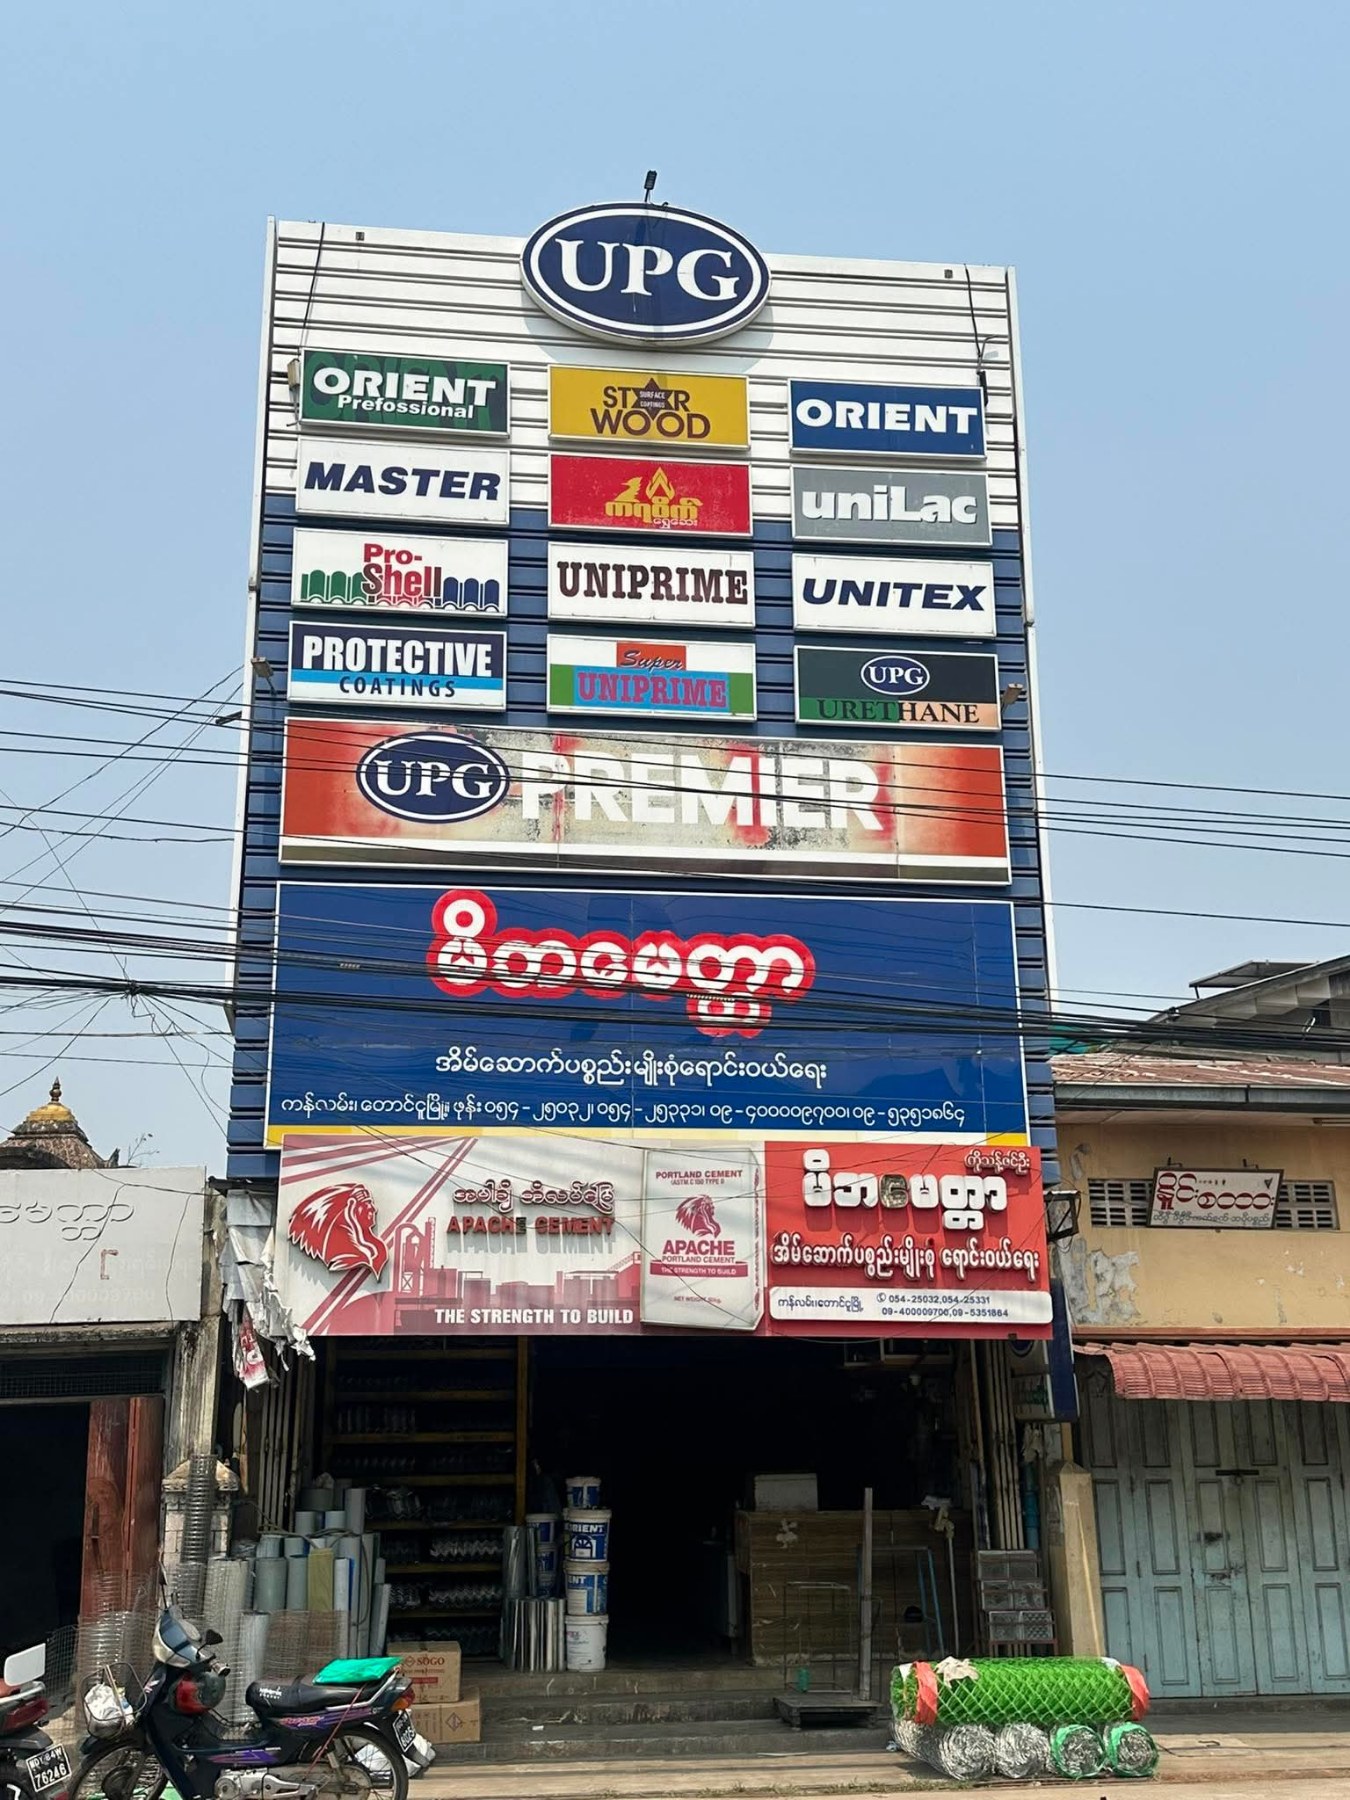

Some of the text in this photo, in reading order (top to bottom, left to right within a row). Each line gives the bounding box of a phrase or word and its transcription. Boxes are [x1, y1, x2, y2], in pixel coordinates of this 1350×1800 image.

[555, 237, 740, 301] UPG
[313, 366, 496, 406] ORIENT
[639, 390, 666, 399] SURFACE
[337, 394, 474, 419] Prefossional
[796, 398, 978, 434] ORIENT
[590, 408, 711, 439] WOOD
[304, 462, 501, 501] MASTER
[802, 484, 977, 524] uniLac
[363, 543, 422, 565] Pro-
[361, 562, 442, 597] Shell
[557, 561, 748, 604] UNIPRIME
[802, 578, 987, 611] UNITEX
[302, 635, 492, 677] PROTECTIVE
[620, 650, 683, 673] Super
[339, 676, 455, 697] COATINGS
[868, 666, 924, 686] UPG
[577, 672, 727, 708] UNIPRIME
[816, 699, 980, 724] URETHANE
[372, 759, 493, 799] UPG
[521, 750, 883, 831] PREMIER
[656, 1169, 743, 1179] PORTLAND CEMENT
[446, 1216, 616, 1235] APACHE CEMENT
[662, 1239, 735, 1255] APACHE
[662, 1255, 736, 1264] PORTLAND CEMENT
[434, 1308, 634, 1325] THE STRENGTH TO BUILD
[416, 1656, 445, 1666] SOGO
[34, 1763, 67, 1789] 76246
